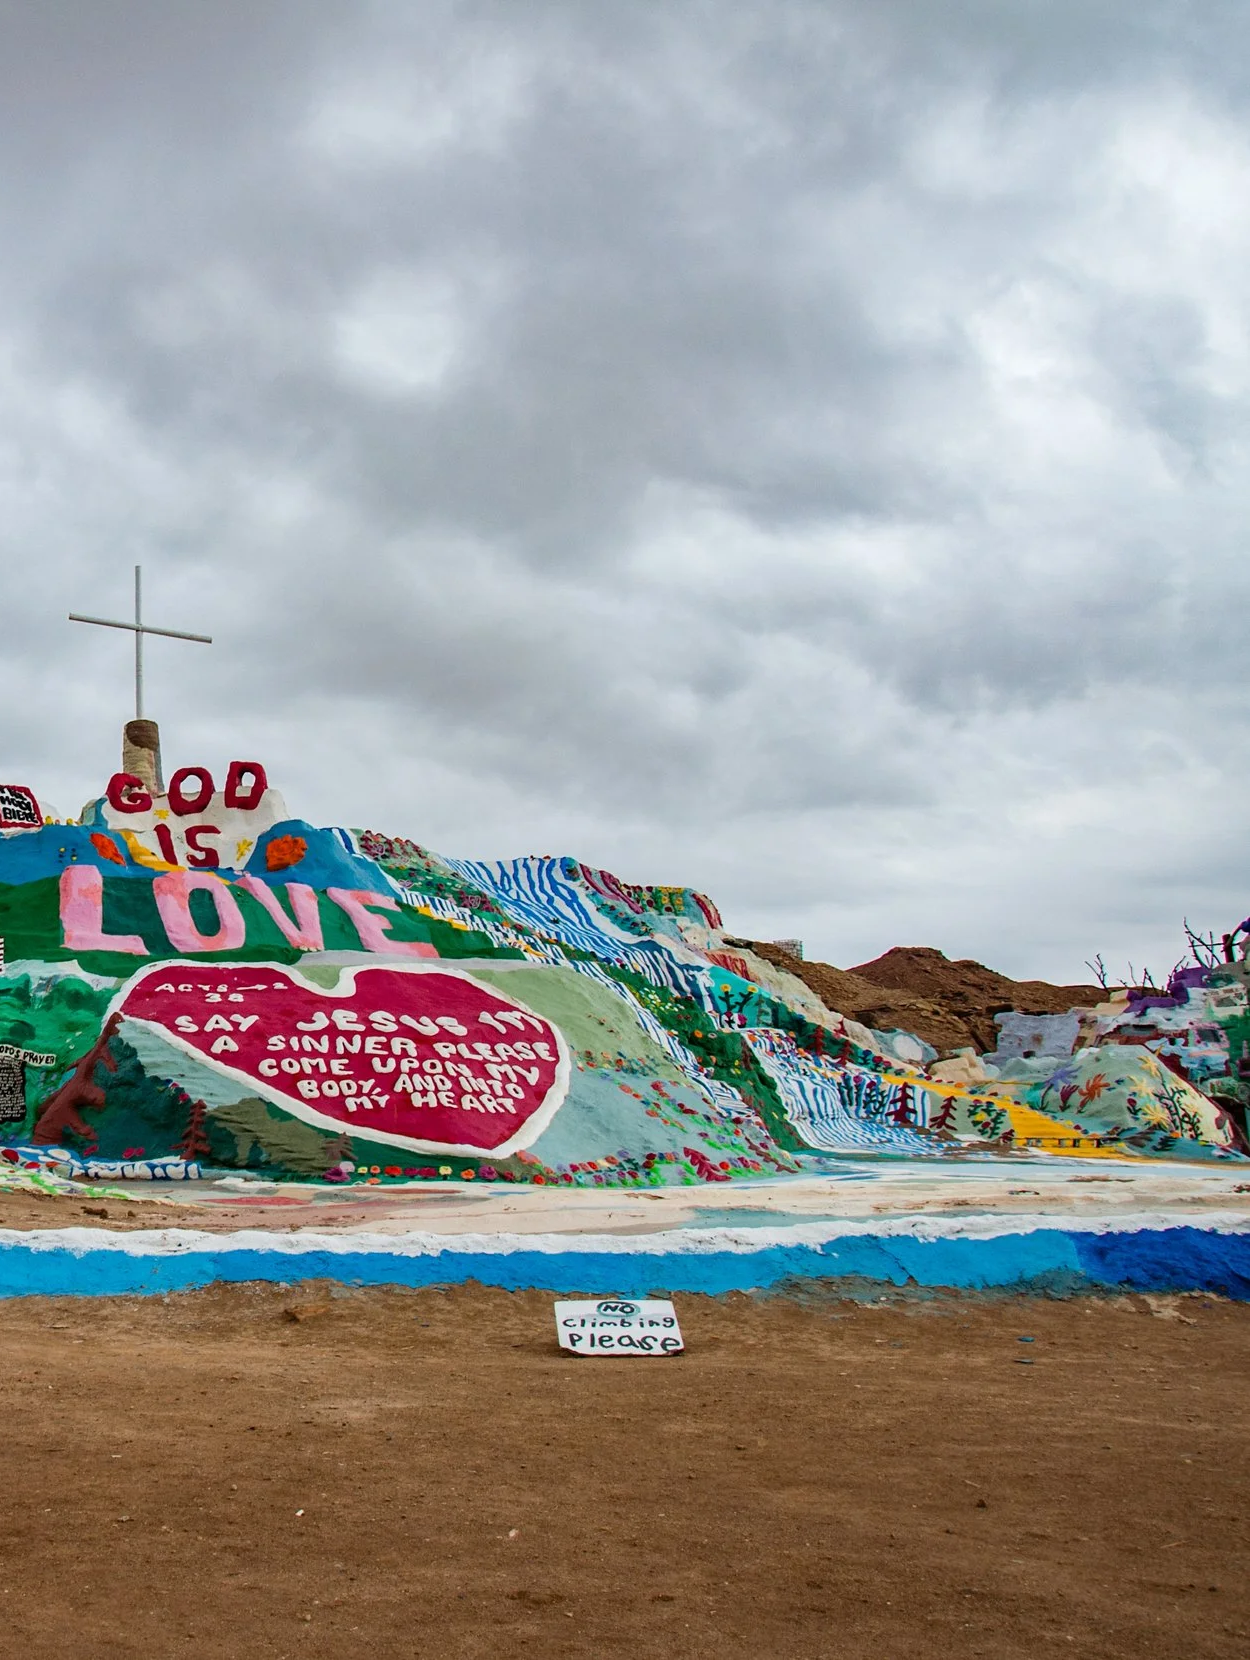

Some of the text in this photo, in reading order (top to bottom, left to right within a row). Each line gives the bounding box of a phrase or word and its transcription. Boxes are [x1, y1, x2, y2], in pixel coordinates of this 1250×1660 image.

[106, 761, 268, 816] GOD
[153, 823, 221, 868] IS
[59, 864, 439, 958] LOVE
[155, 982, 288, 993] ACTS 2
[205, 992, 244, 1003] 38
[175, 1009, 544, 1036] SAY JESUS IM
[23, 1051, 55, 1064] PRAYER
[210, 1034, 556, 1062] A SINNER PLEASE
[258, 1057, 540, 1086] COME UPON MY
[393, 1073, 453, 1094] AND
[458, 1076, 525, 1099] INTO
[345, 1091, 517, 1114] MY HEART
[602, 1304, 635, 1314] NO
